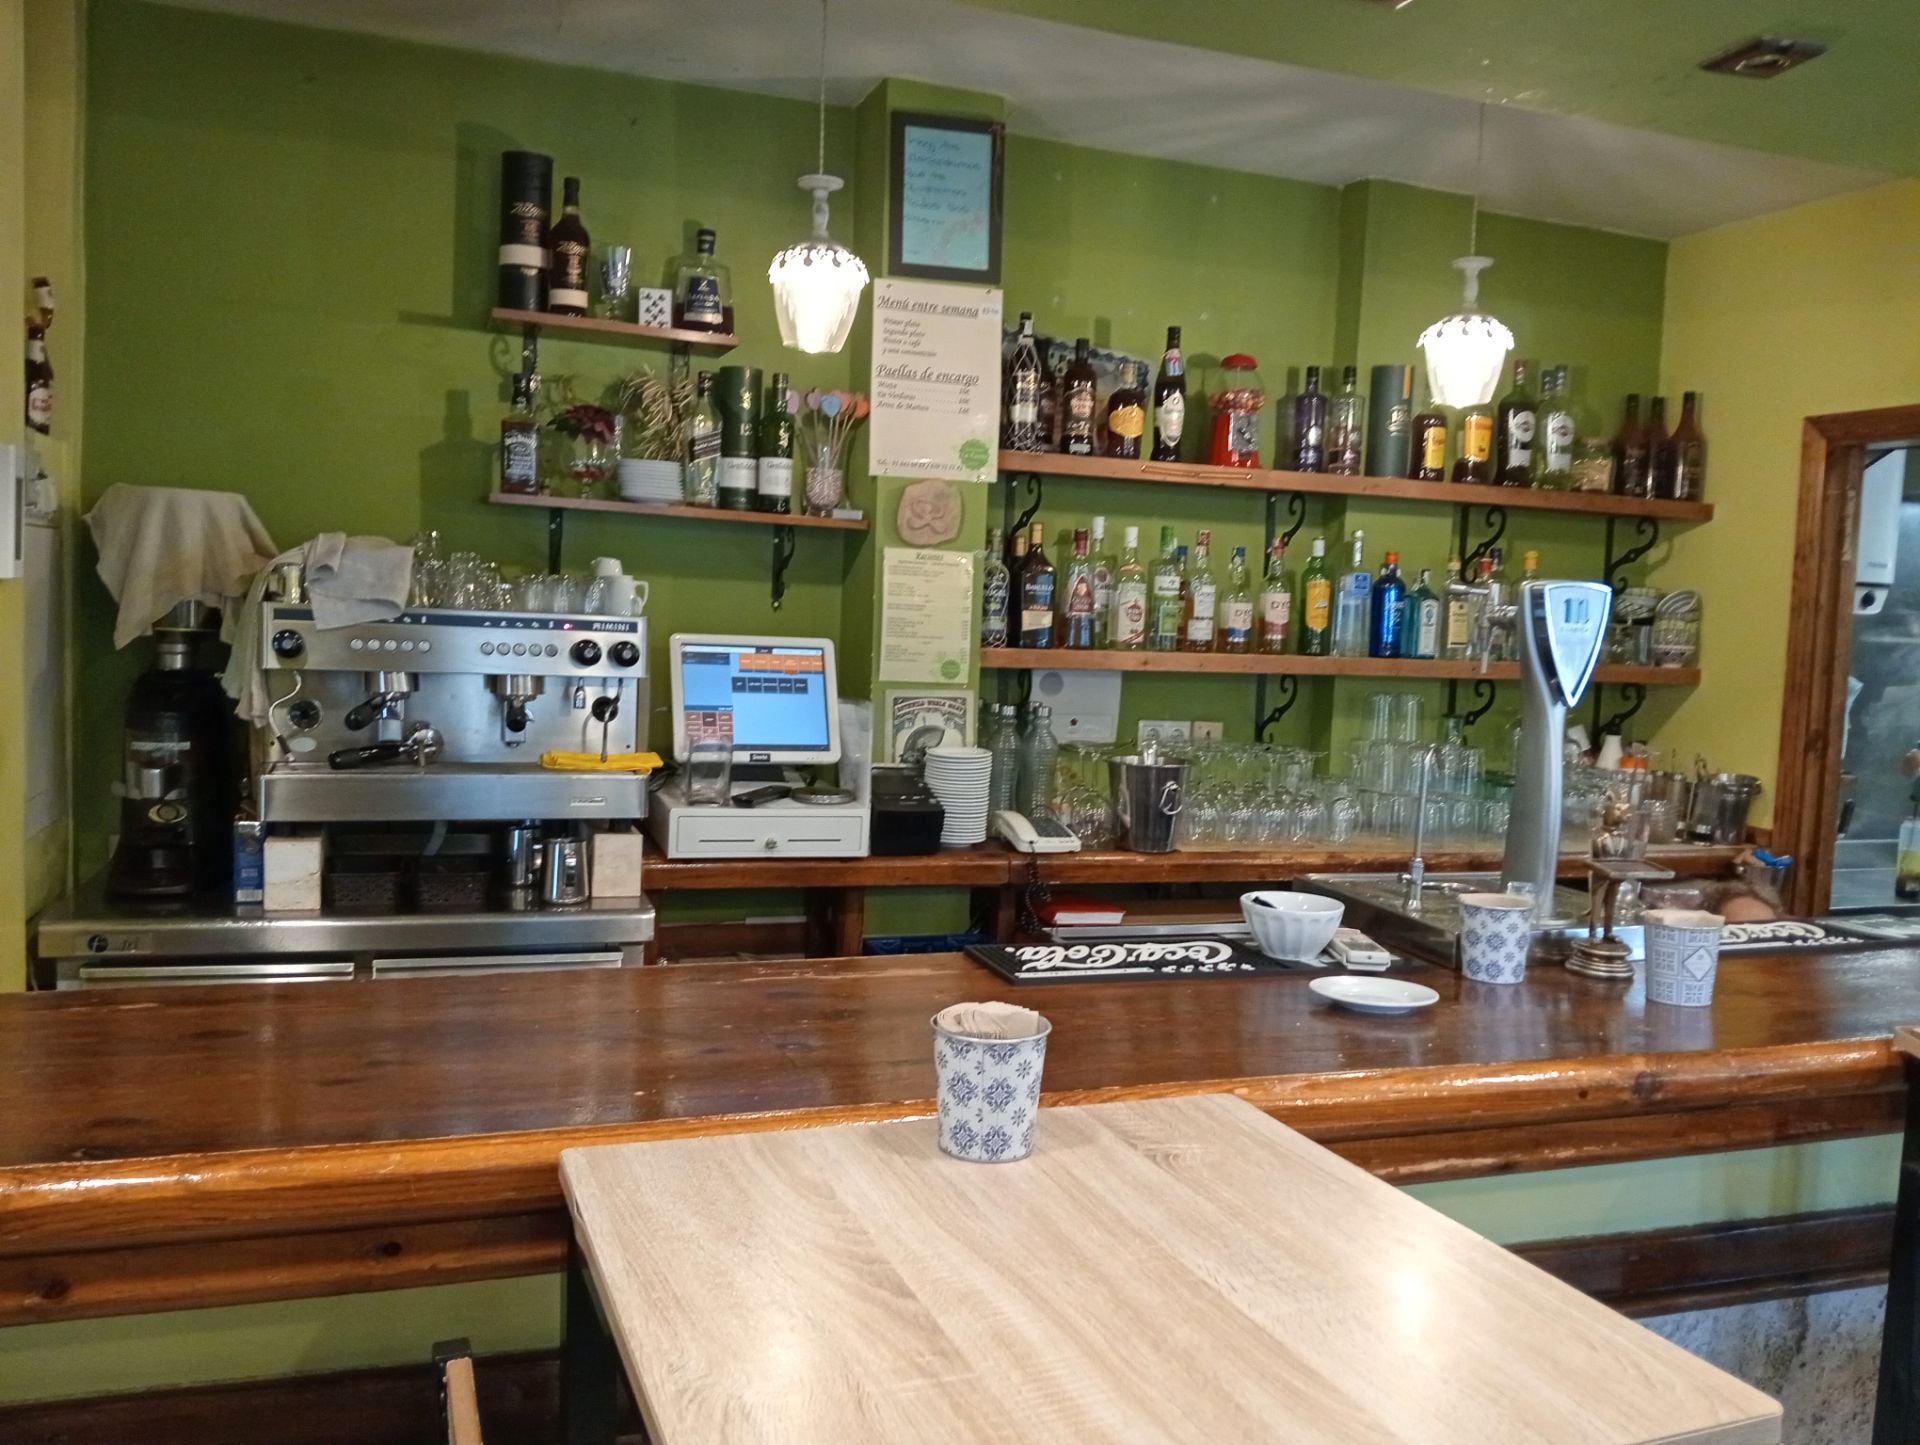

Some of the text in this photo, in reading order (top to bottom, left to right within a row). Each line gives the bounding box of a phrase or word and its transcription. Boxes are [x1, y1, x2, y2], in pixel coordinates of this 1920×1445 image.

[940, 304, 979, 318] semana
[876, 364, 980, 388] Paellas de encargo
